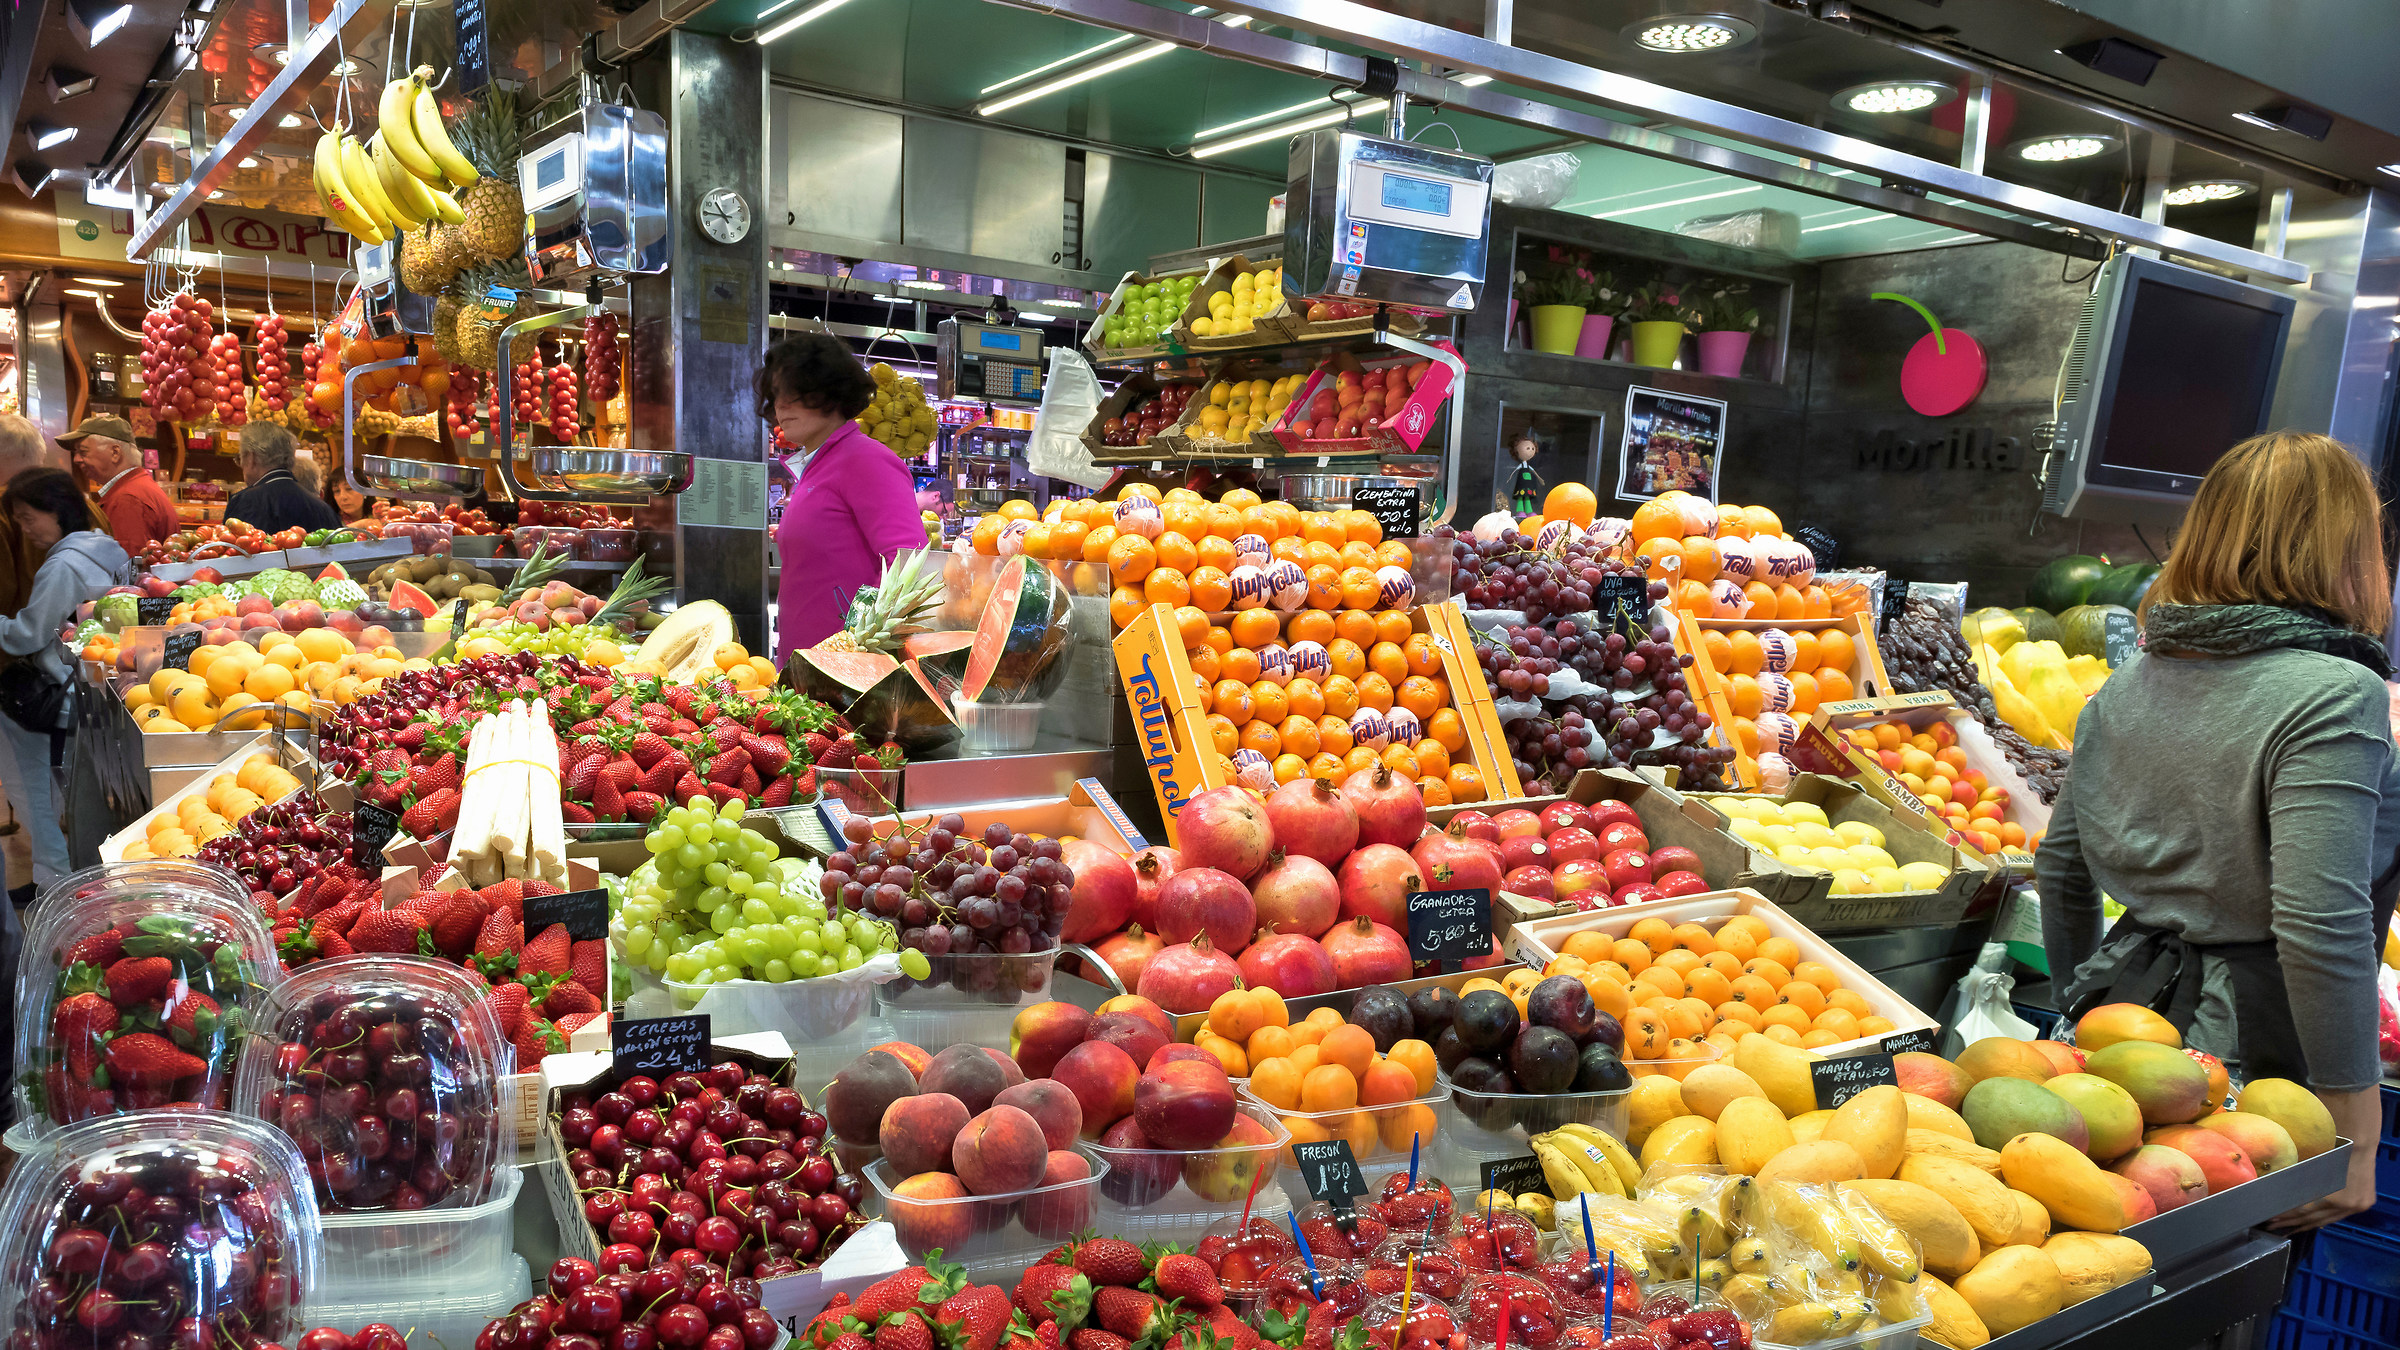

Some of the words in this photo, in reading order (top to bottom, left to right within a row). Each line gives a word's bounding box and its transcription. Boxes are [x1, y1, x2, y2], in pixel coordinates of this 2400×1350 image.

[76, 225, 99, 236] 428
[484, 297, 516, 309] FRUNET
[1656, 398, 1685, 416] Morilla
[1856, 427, 2027, 472] Morilla
[1355, 488, 1415, 501] CLEMENTINA
[1376, 498, 1406, 507] EXTRA
[1604, 577, 1623, 589] UVA
[1833, 701, 1876, 713] SAMBA
[1904, 693, 1946, 705] SAMBA
[1808, 733, 1847, 773] FRUTAS
[1883, 775, 1928, 818] SAMBA
[1409, 894, 1477, 912] GRANADAS
[1439, 906, 1475, 918] EXTRA
[625, 1019, 697, 1038] CEREZAS
[1886, 1034, 1921, 1052] MANGA
[635, 1048, 682, 1069] 24
[1815, 1060, 1863, 1076] MANGO
[1300, 1140, 1341, 1161] FRESON
[1316, 1161, 1351, 1196] 1'50
